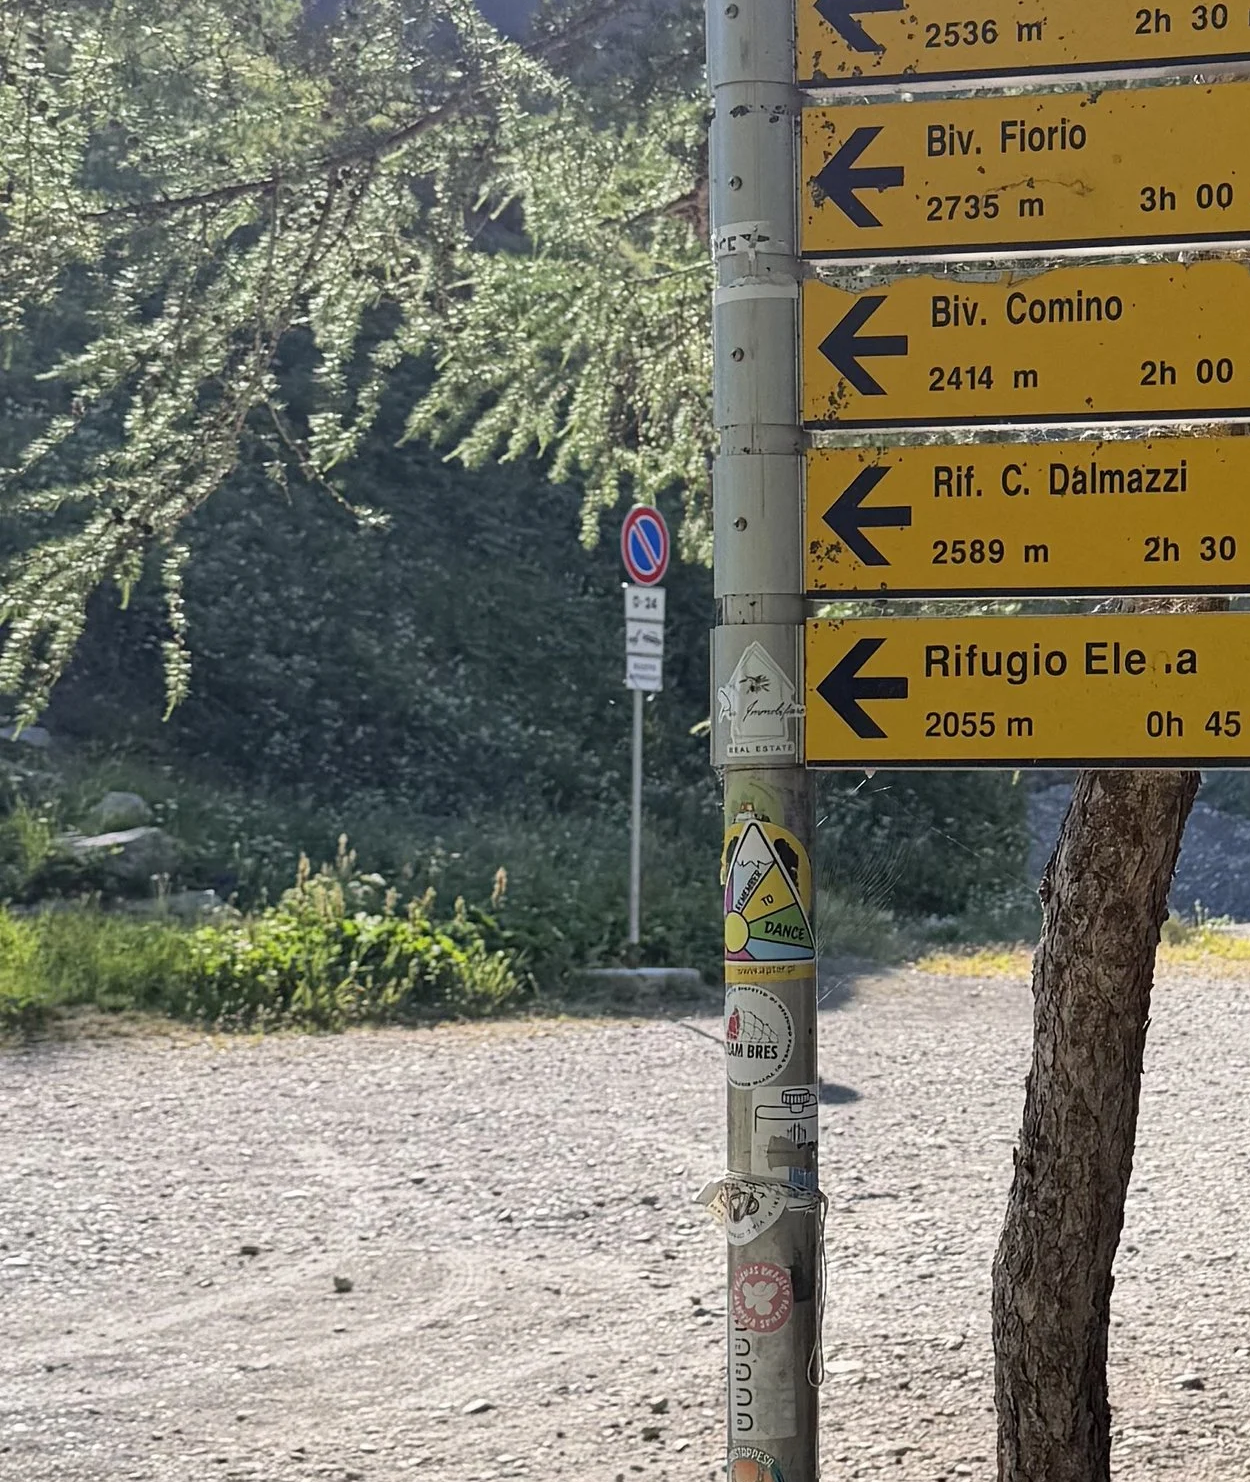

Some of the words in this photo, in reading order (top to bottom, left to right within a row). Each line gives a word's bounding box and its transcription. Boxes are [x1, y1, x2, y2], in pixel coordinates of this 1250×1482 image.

[1135, 8, 1171, 35] 2h
[1191, 3, 1228, 31] 30
[925, 19, 999, 49] 2536
[1016, 20, 1042, 42] m
[927, 123, 982, 157] Biv.
[1000, 117, 1087, 154] Fiorio
[926, 193, 1000, 222] 2735
[1019, 197, 1044, 218] m
[1140, 186, 1176, 213] 3h
[1196, 182, 1234, 211] 00
[931, 294, 987, 328] Biv.
[1006, 289, 1123, 325] Comino
[928, 365, 994, 392] 2414
[1013, 369, 1038, 389] m
[1140, 360, 1177, 386] 2h
[934, 465, 982, 498] Rif.
[1001, 463, 1030, 497] C.
[1049, 459, 1187, 497] Dalmazzi
[931, 538, 1005, 565] 2589
[1024, 544, 1049, 563] m
[1143, 535, 1180, 562] 2h
[1199, 535, 1236, 562] 30
[925, 642, 1068, 685] Rifugio
[1085, 641, 1198, 676] Elea
[925, 711, 996, 738] 2055
[1007, 716, 1033, 737] m
[1146, 710, 1183, 738] 0h
[1204, 710, 1241, 738] 45
[756, 744, 793, 753] ESTATE
[735, 869, 762, 911] REMEMBER
[760, 894, 774, 907] TO
[764, 921, 805, 940] DANCE
[747, 1043, 778, 1059] BRES
